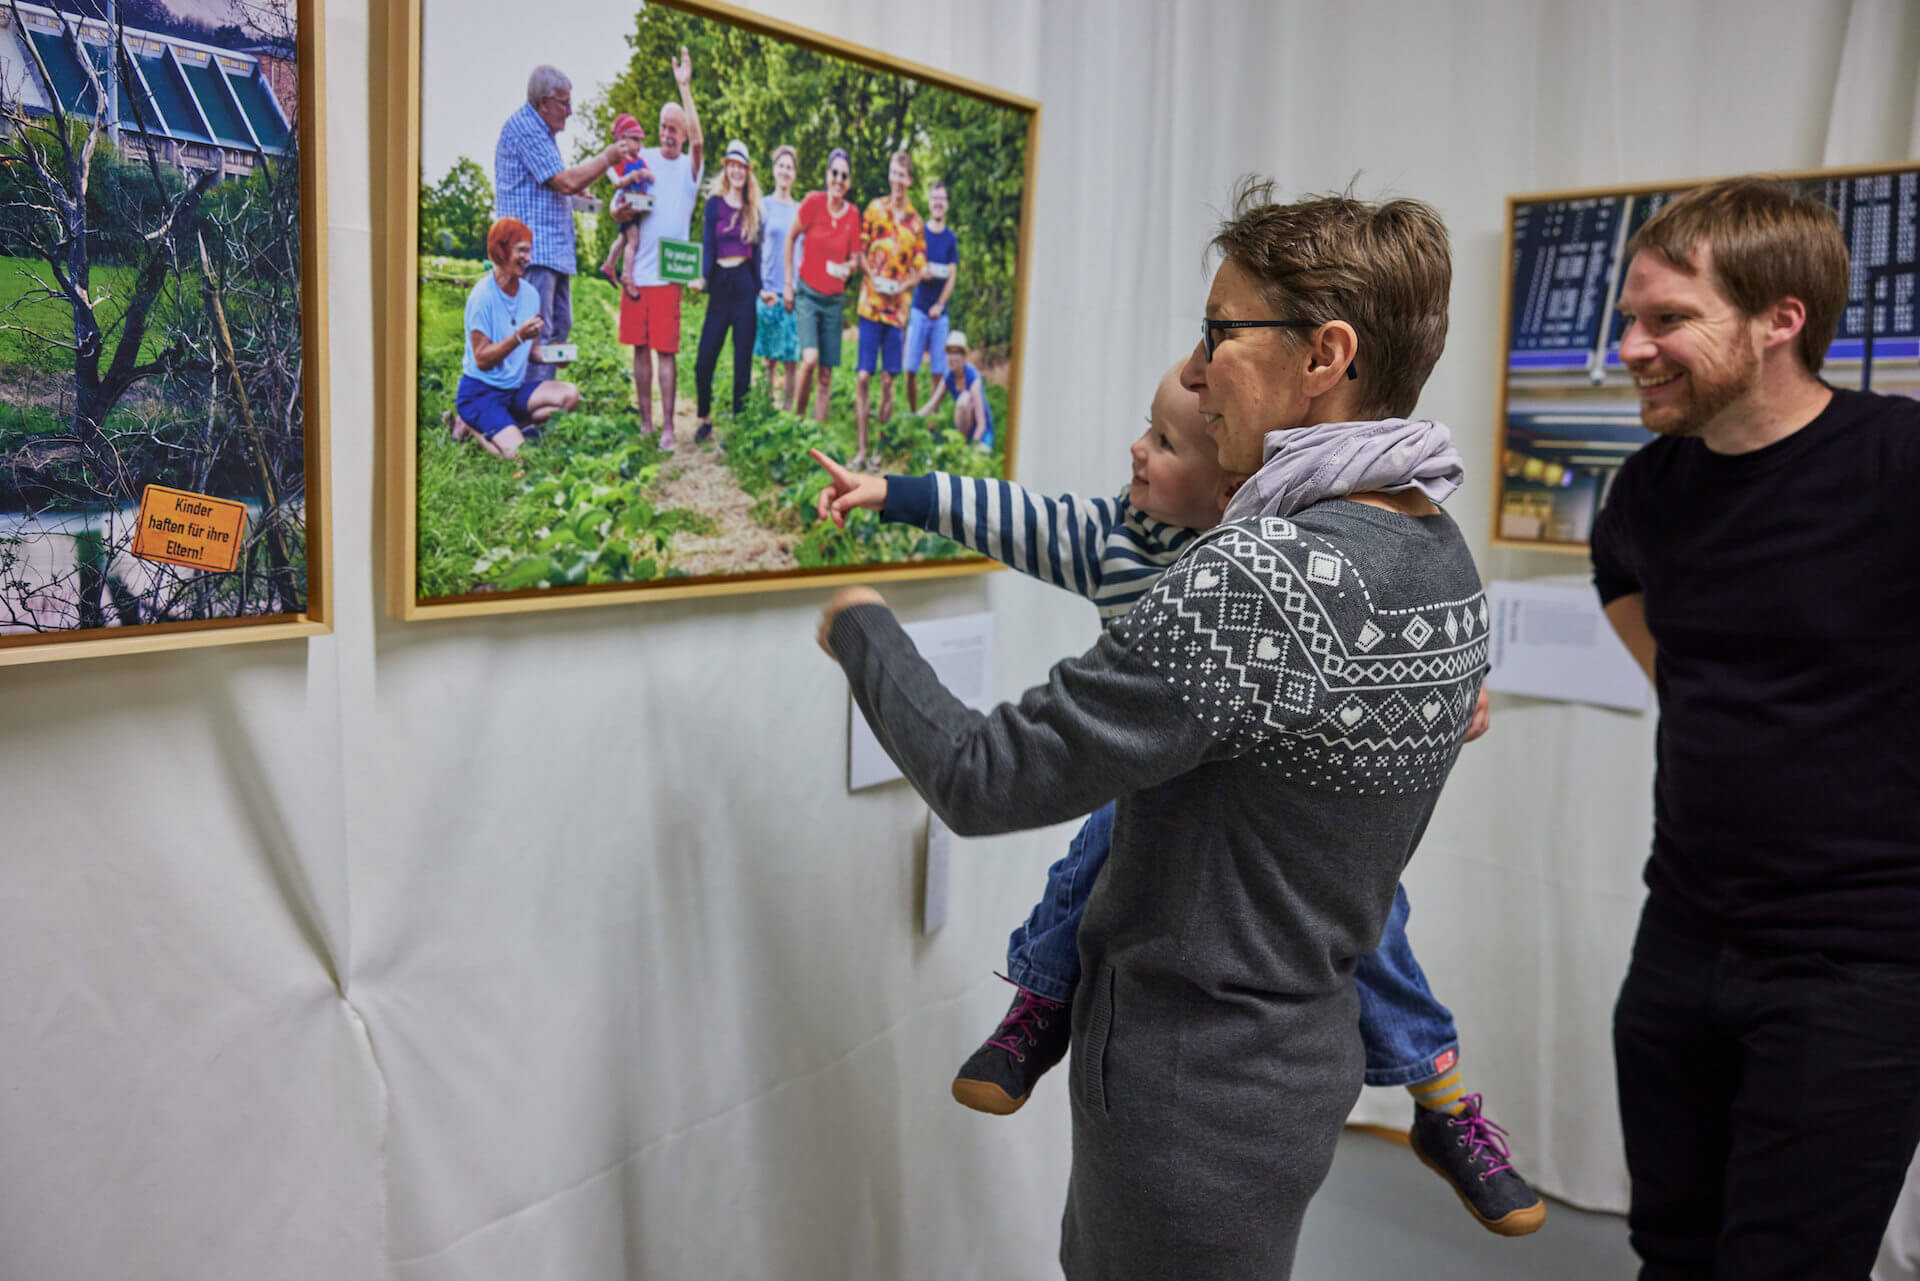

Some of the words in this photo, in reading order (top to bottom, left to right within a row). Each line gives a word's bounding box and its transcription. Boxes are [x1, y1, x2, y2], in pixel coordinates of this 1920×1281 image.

[175, 498, 213, 517] Kinder
[148, 515, 184, 534] haften
[188, 522, 205, 538] für
[207, 526, 230, 543] ihre
[166, 540, 204, 560] Eltern!
